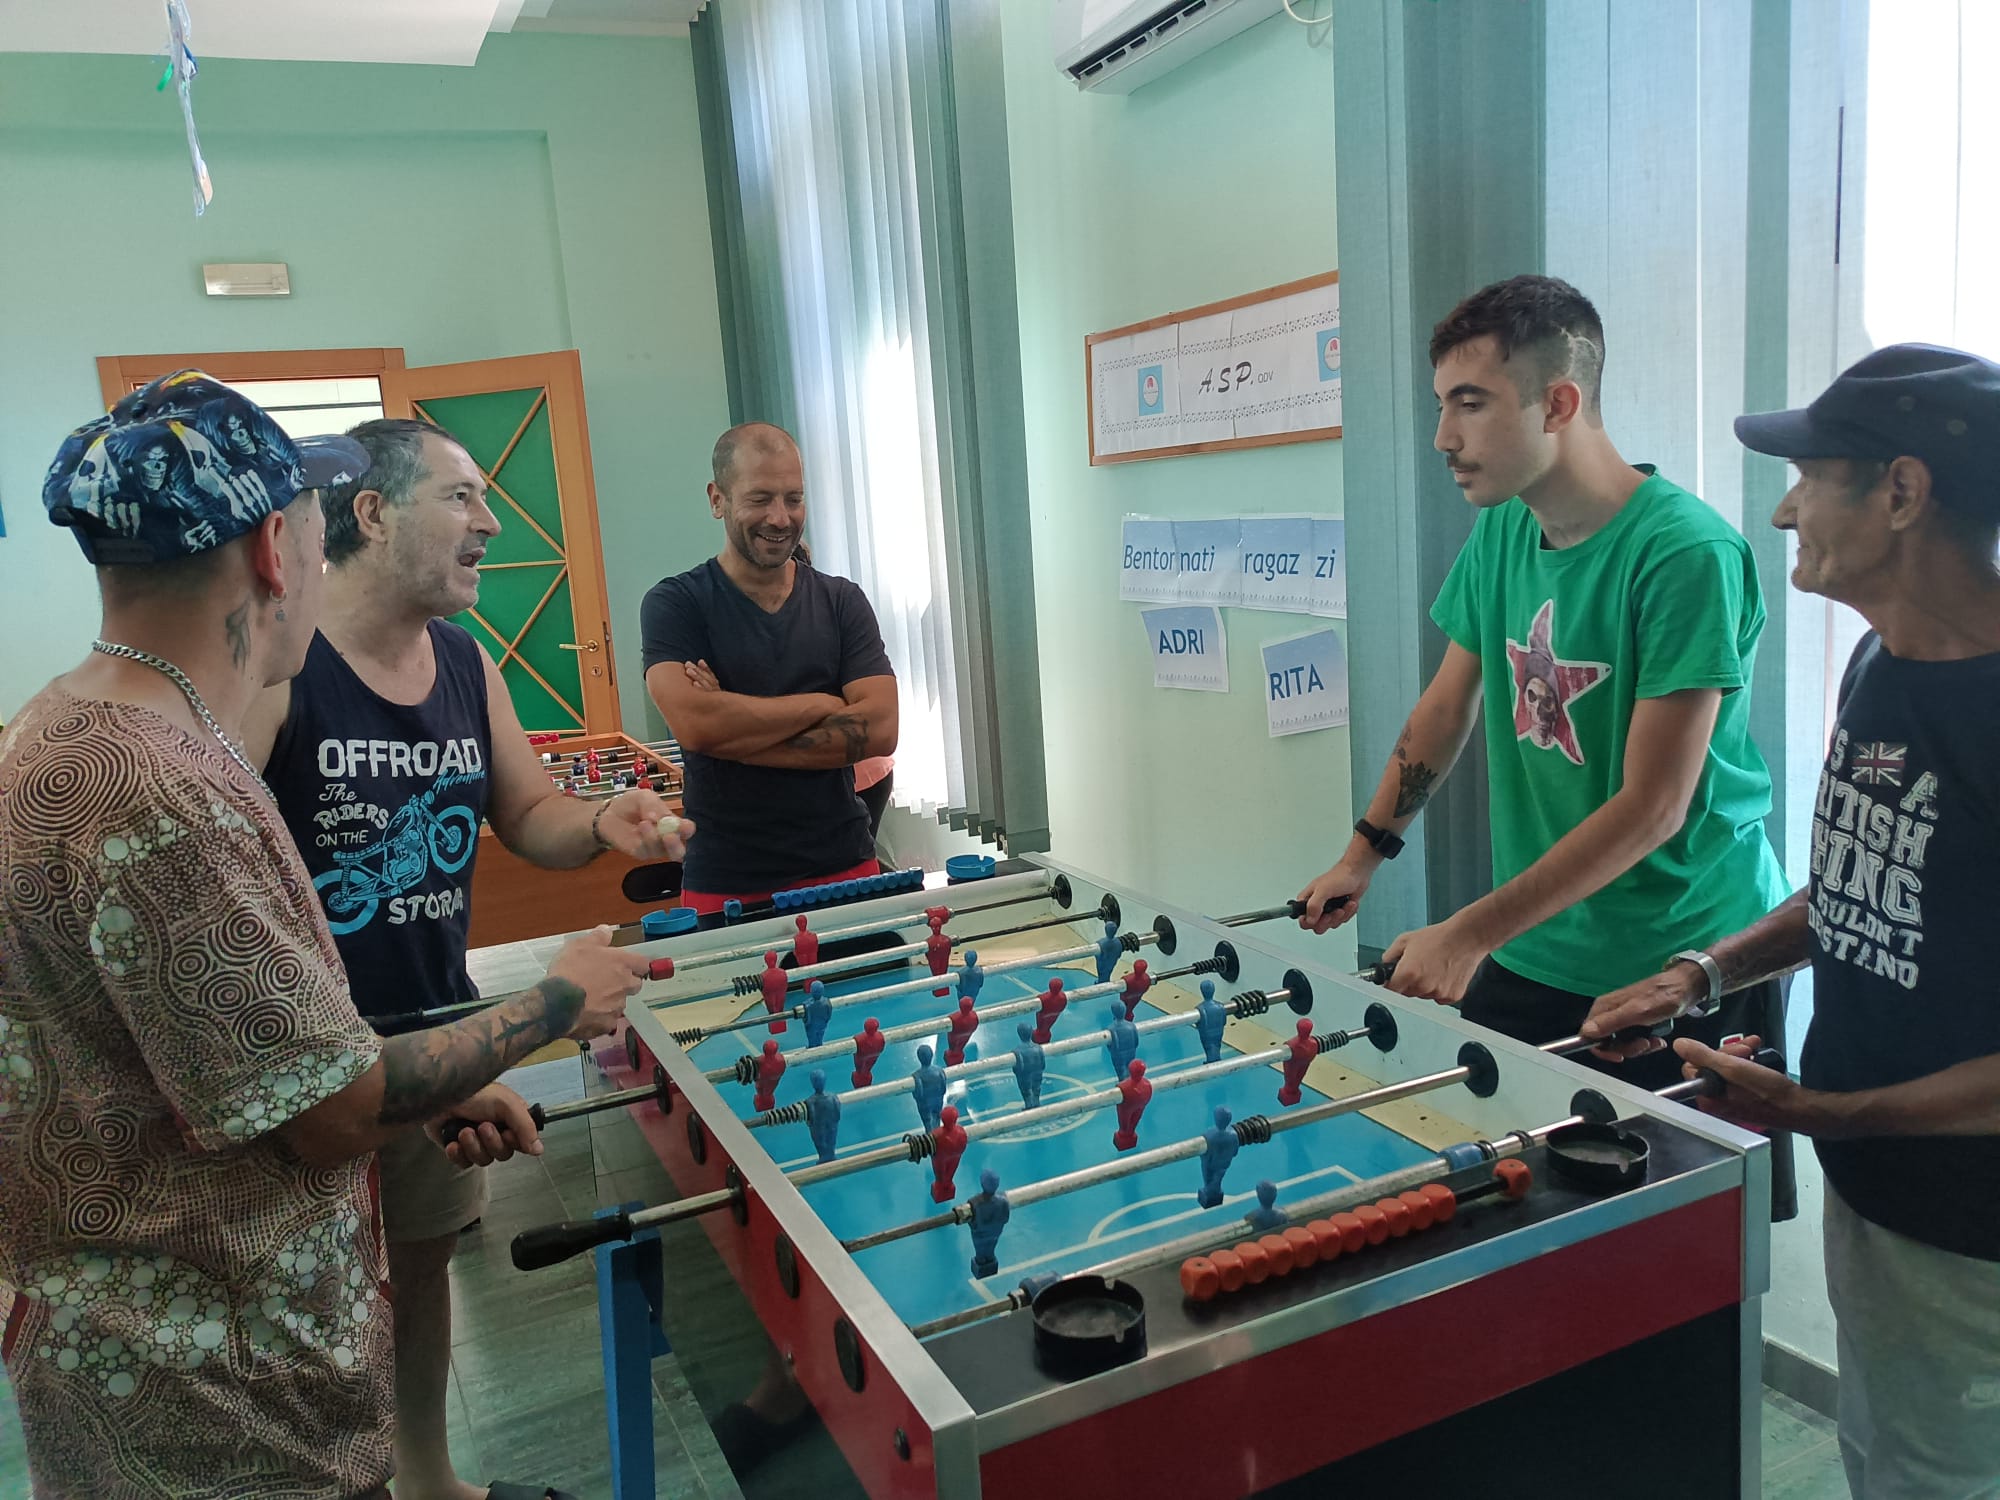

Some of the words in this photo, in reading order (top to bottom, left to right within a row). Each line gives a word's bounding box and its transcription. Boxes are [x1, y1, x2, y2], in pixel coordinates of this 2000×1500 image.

[1159, 629, 1205, 655] ADRI
[1269, 663, 1325, 701] RITA
[317, 738, 482, 778] OFFROAD
[318, 783, 357, 801] The
[1899, 770, 1939, 820] A
[313, 803, 389, 830] RIDERS
[315, 833, 337, 847] ON
[341, 830, 369, 846] THE
[387, 887, 463, 925] STORM
